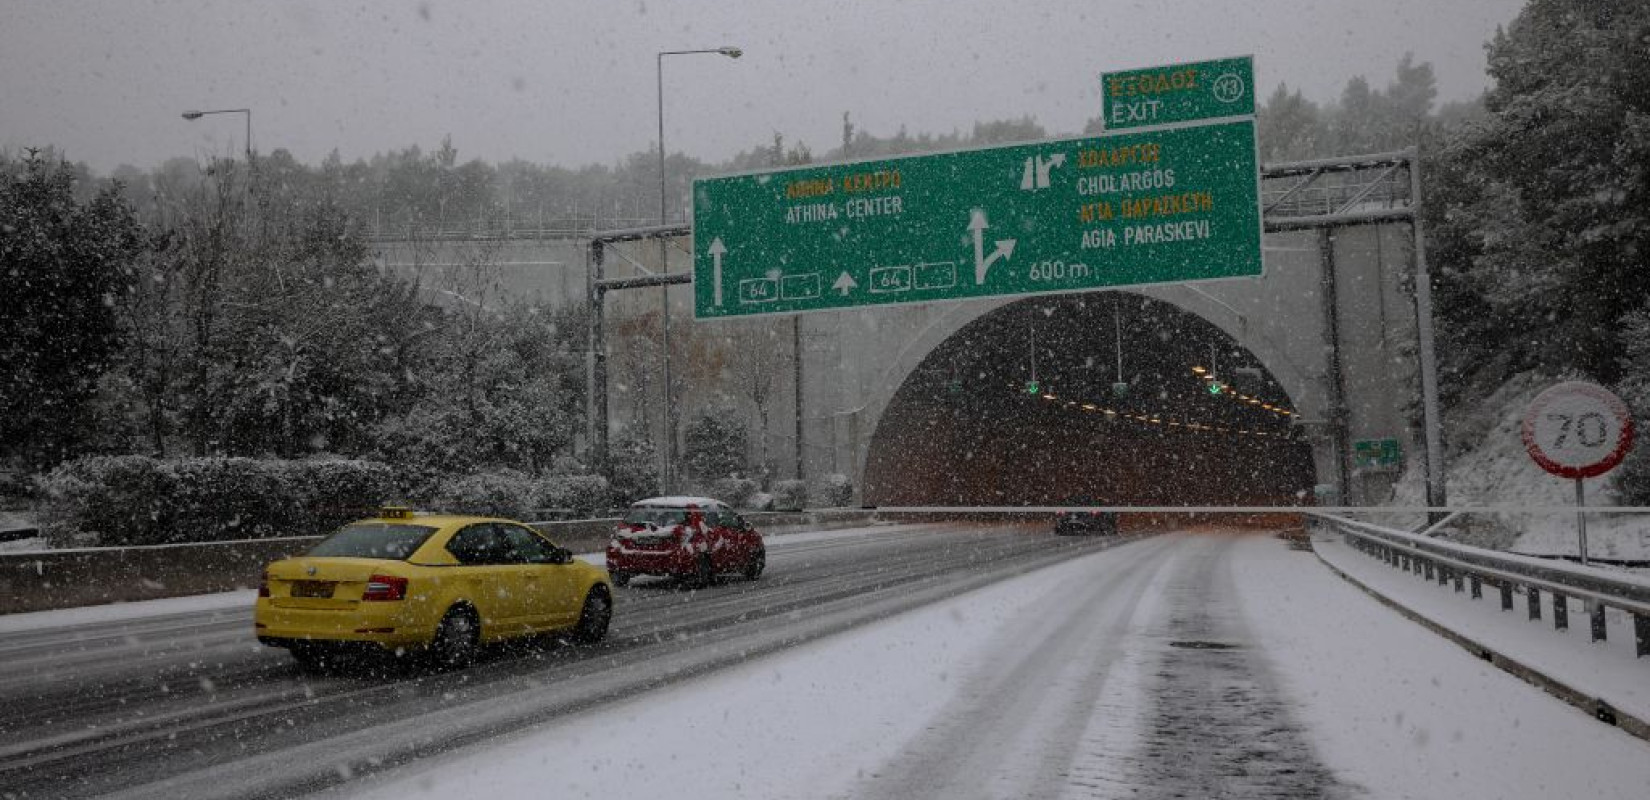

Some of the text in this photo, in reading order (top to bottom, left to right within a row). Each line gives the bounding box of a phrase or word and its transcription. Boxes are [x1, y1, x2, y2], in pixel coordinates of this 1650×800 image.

[1112, 101, 1161, 123] EXIT
[1078, 169, 1175, 195] CHOLARGOS
[1081, 219, 1210, 249] AGIA PARASKEVI
[882, 272, 901, 287] 64
[1029, 262, 1089, 280] 600 m
[750, 282, 767, 297] 64
[1547, 411, 1608, 449] 70
